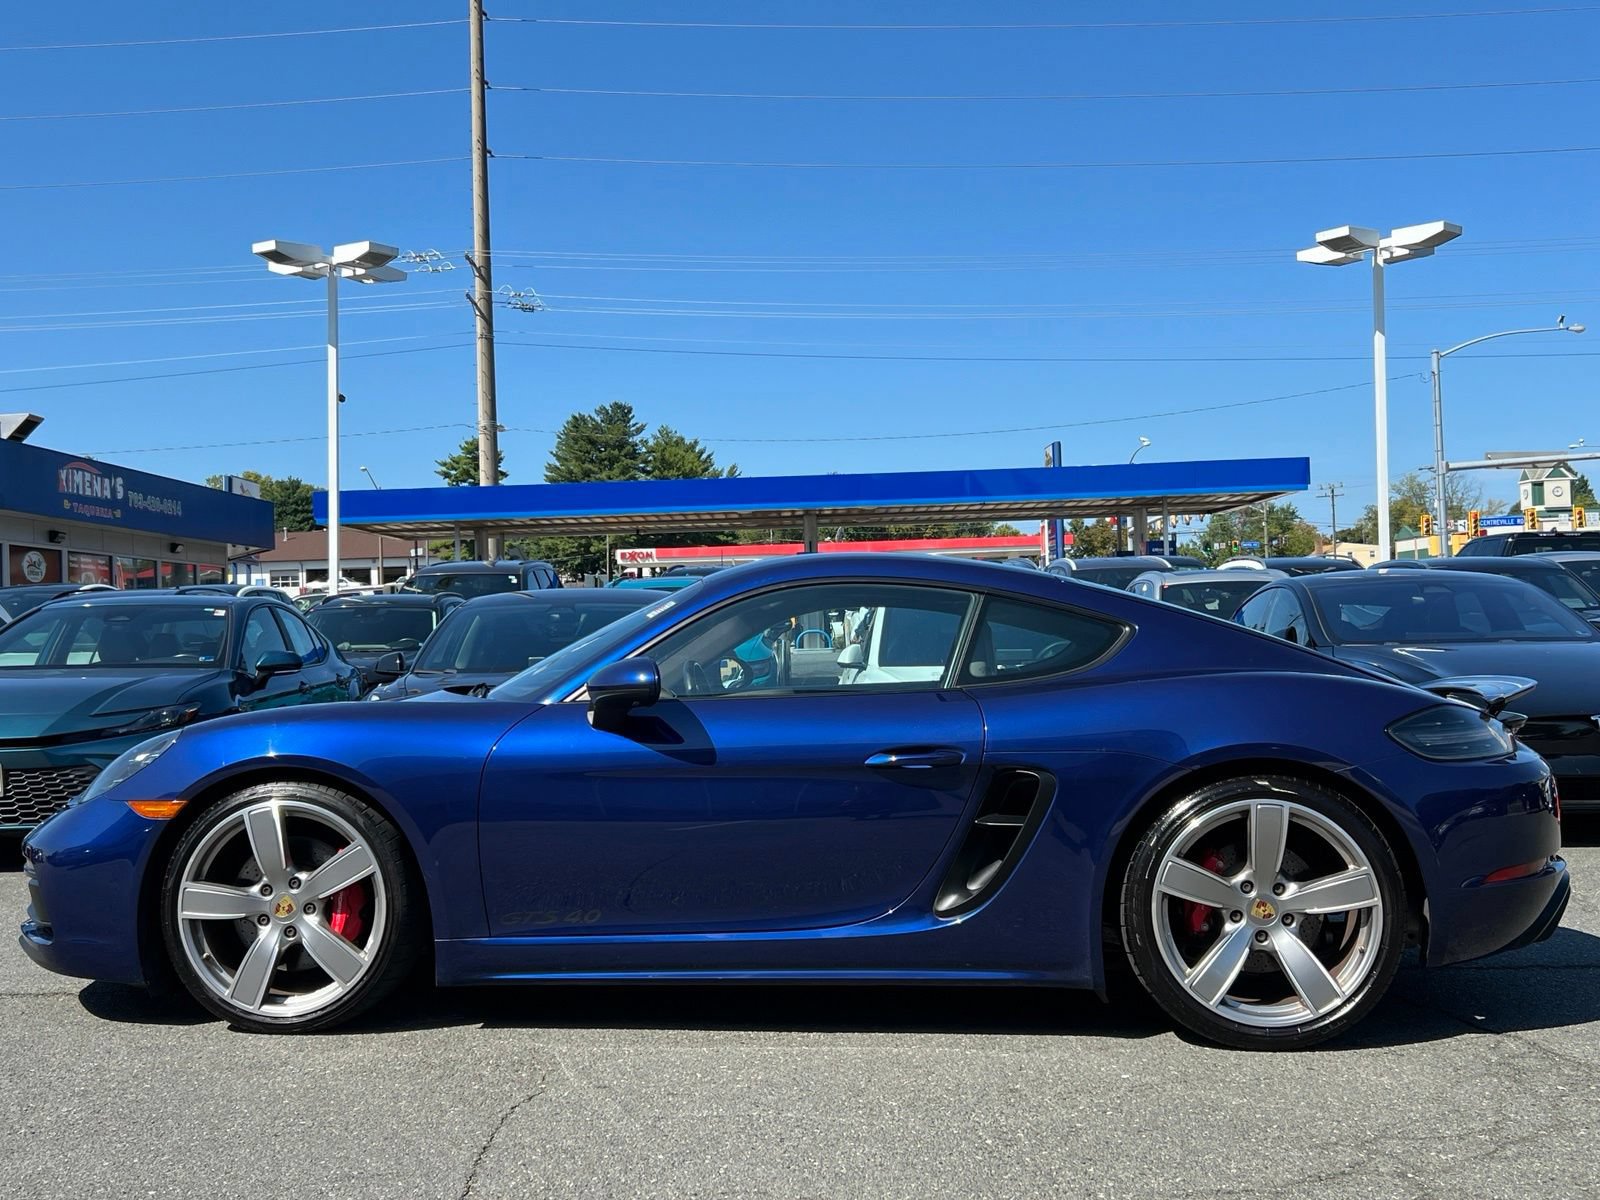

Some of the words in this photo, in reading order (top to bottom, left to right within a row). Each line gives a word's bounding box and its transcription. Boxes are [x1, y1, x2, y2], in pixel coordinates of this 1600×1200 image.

[58, 467, 124, 500] XIMENA'S
[1480, 518, 1514, 527] CENTREVILLE
[1516, 518, 1525, 526] RD
[620, 551, 654, 563] EXXON
[500, 910, 560, 925] GTS
